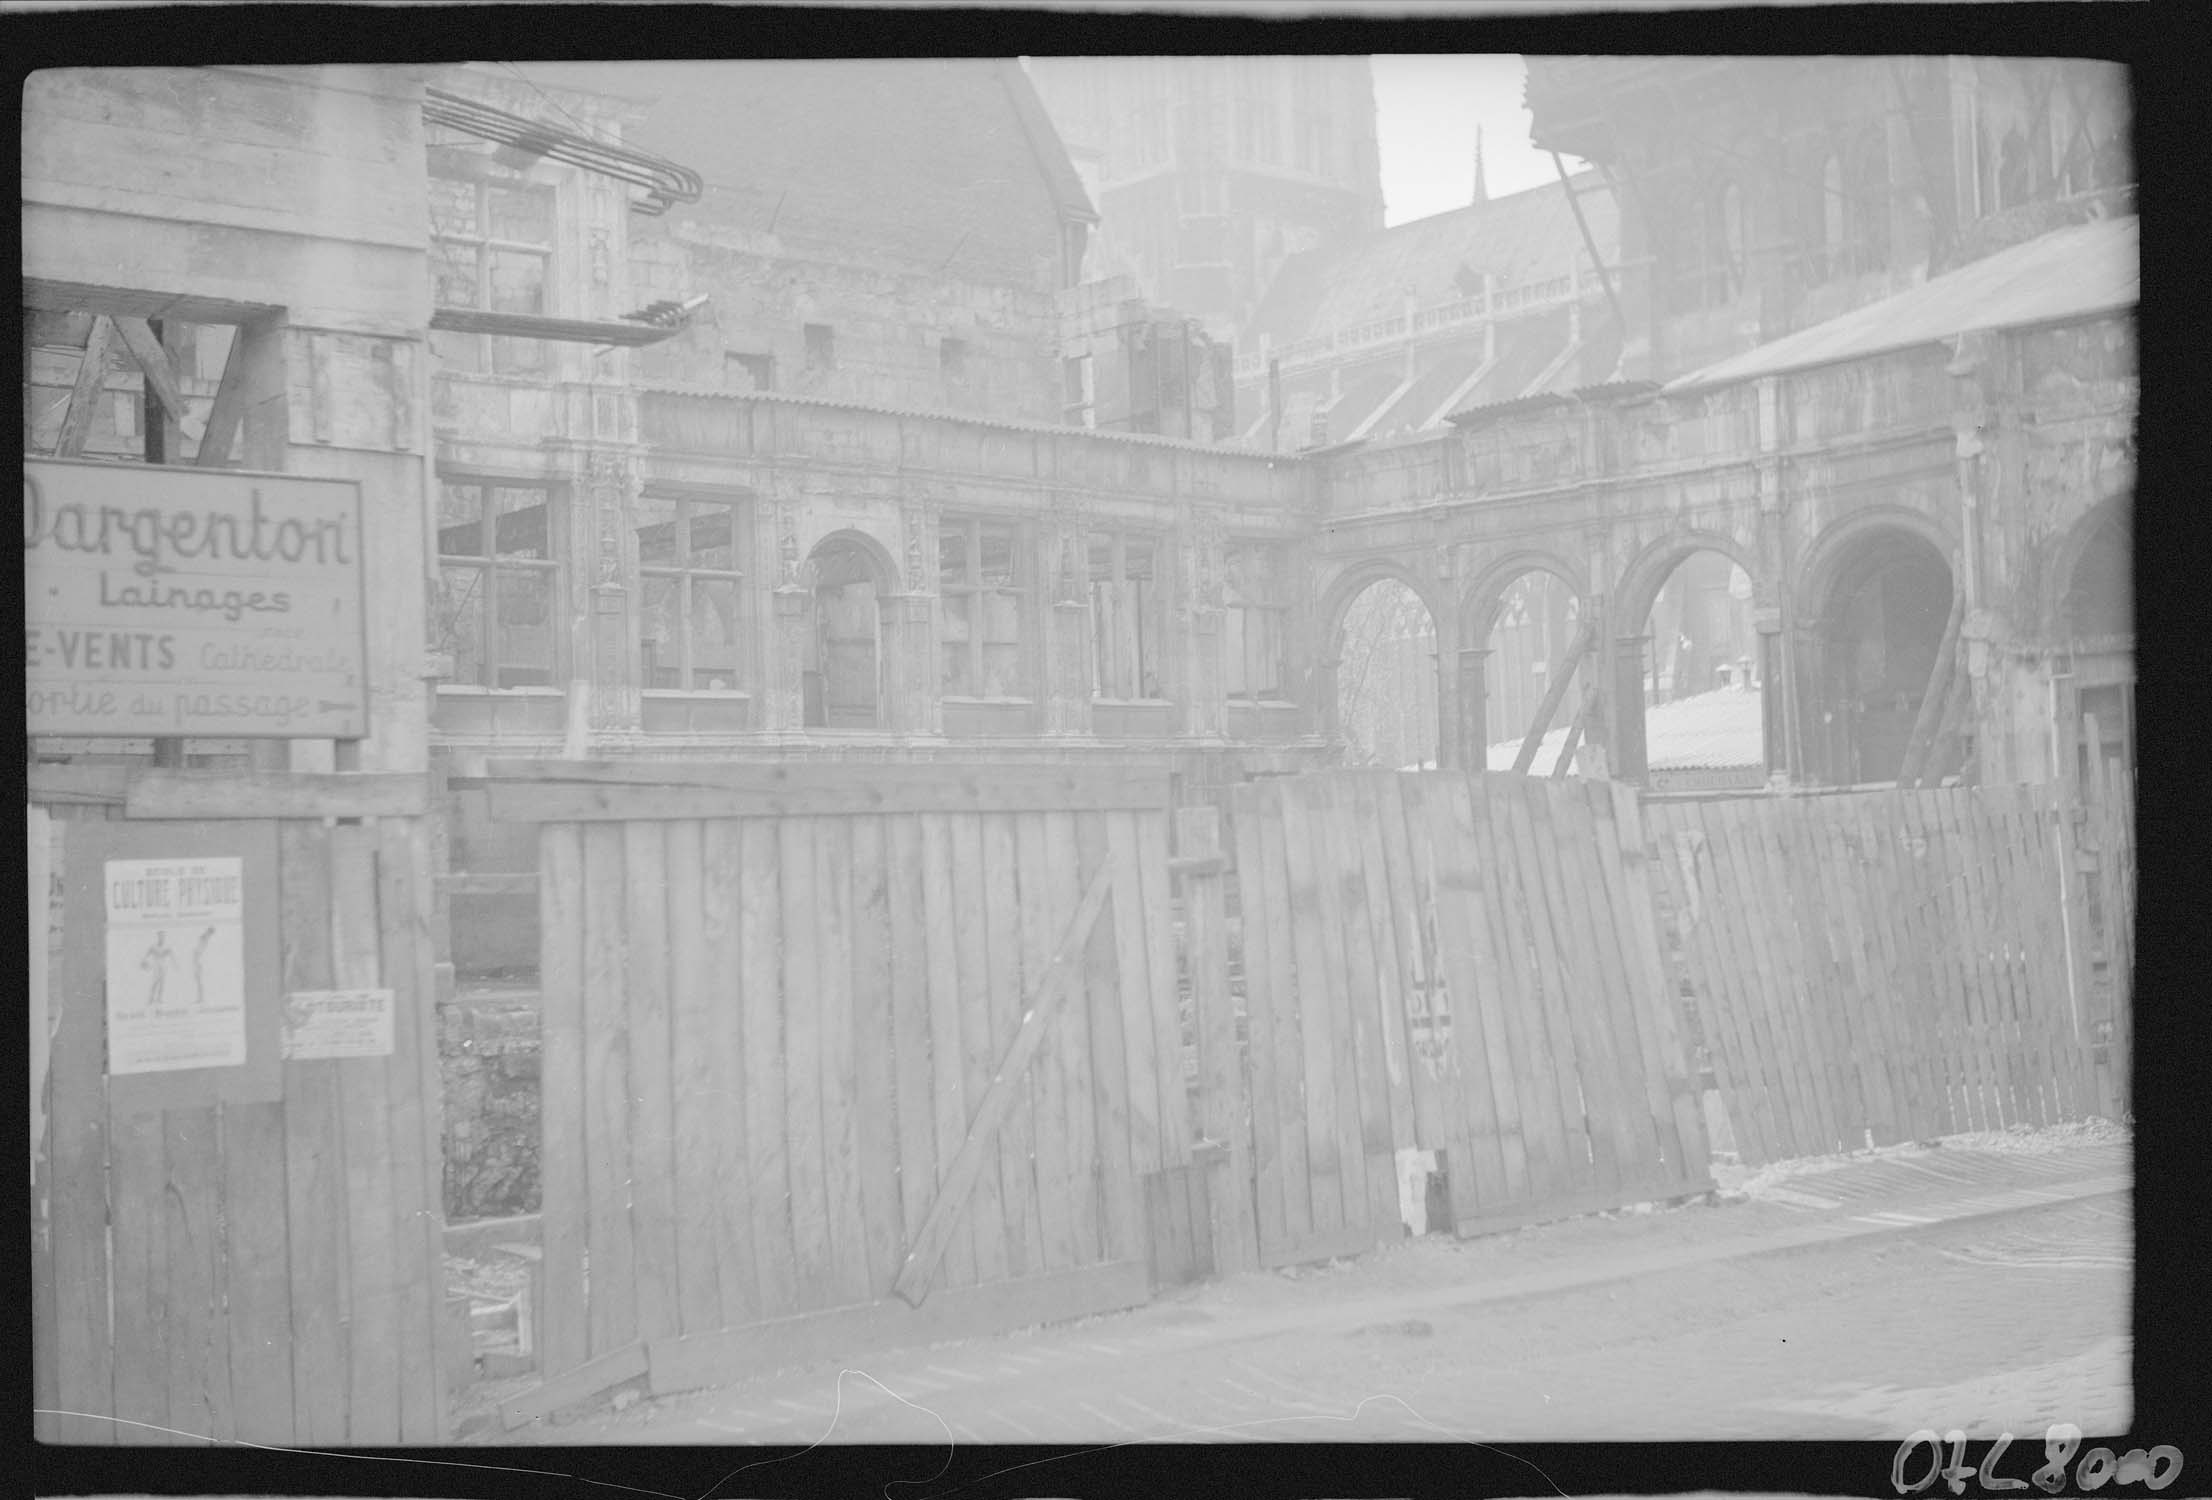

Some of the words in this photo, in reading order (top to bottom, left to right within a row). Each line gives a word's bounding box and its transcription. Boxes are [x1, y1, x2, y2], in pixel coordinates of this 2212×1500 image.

[100, 570, 291, 623] Lainages
[132, 692, 163, 716] du
[176, 694, 309, 727] passage
